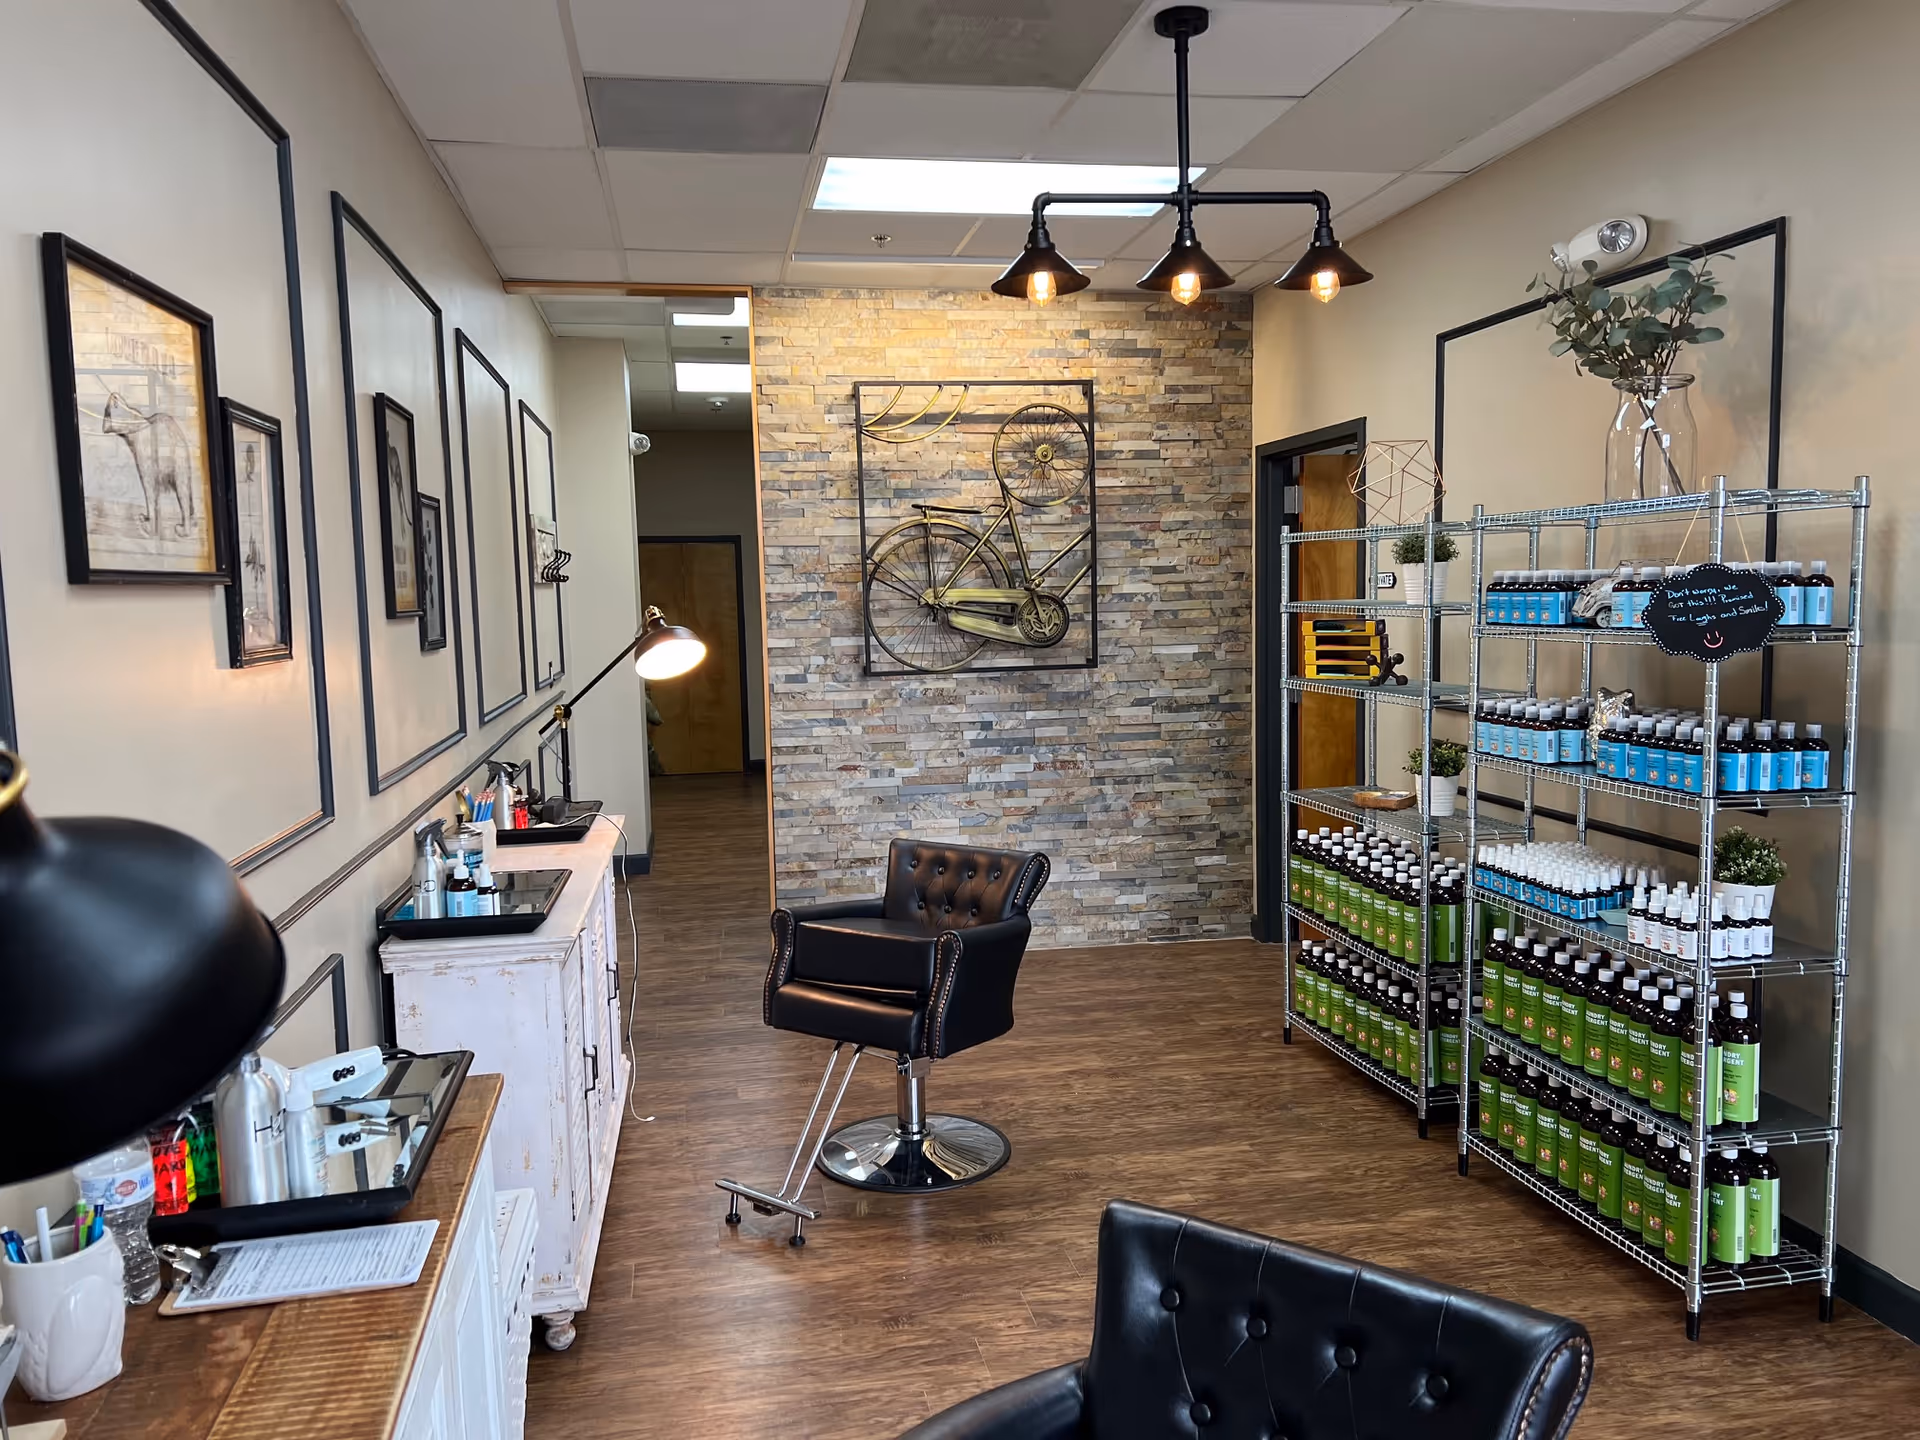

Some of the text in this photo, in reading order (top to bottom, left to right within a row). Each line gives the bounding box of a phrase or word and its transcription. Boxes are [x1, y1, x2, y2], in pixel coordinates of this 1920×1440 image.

[1718, 591, 1754, 604] Promised
[1668, 614, 1686, 622] Free
[1690, 613, 1717, 624] Laughs
[1720, 608, 1738, 618] and
